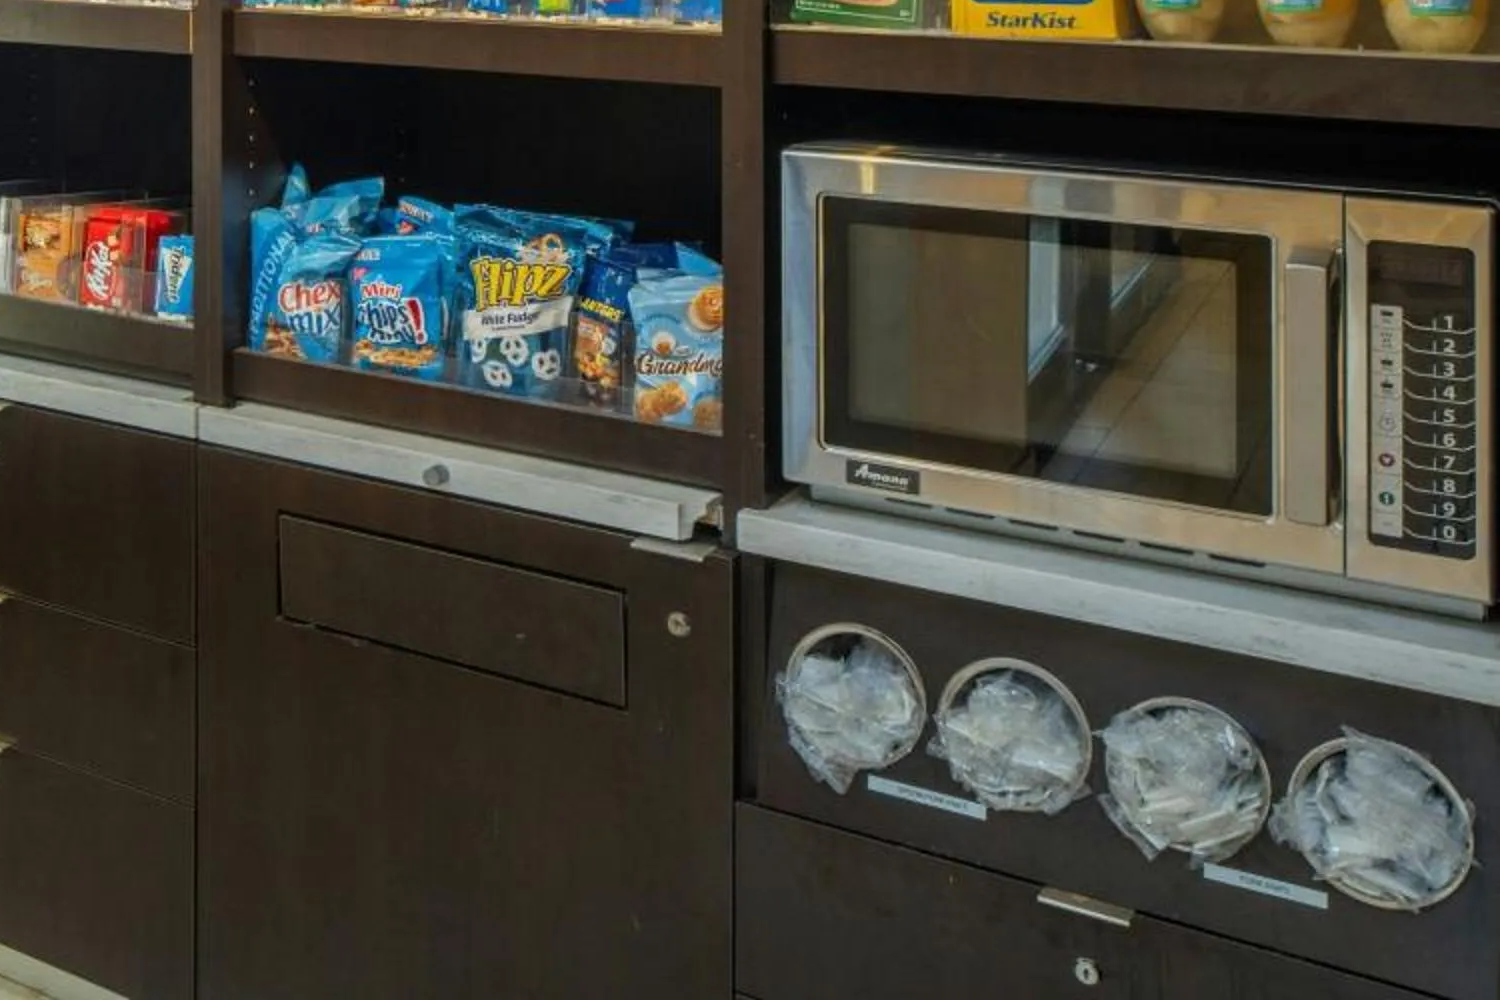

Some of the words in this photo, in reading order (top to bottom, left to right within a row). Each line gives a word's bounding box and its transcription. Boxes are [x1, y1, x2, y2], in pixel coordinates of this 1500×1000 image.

[986, 11, 1077, 29] StarKist
[278, 280, 341, 313] Chex
[1443, 315, 1455, 329] 1
[1443, 339, 1455, 353] 2
[1443, 362, 1455, 377] 3
[1443, 386, 1455, 399] 4
[1443, 409, 1455, 423] 5
[1443, 433, 1455, 447] 6
[1443, 456, 1455, 469] 7
[1443, 479, 1455, 493] 8
[1443, 503, 1455, 516] 9
